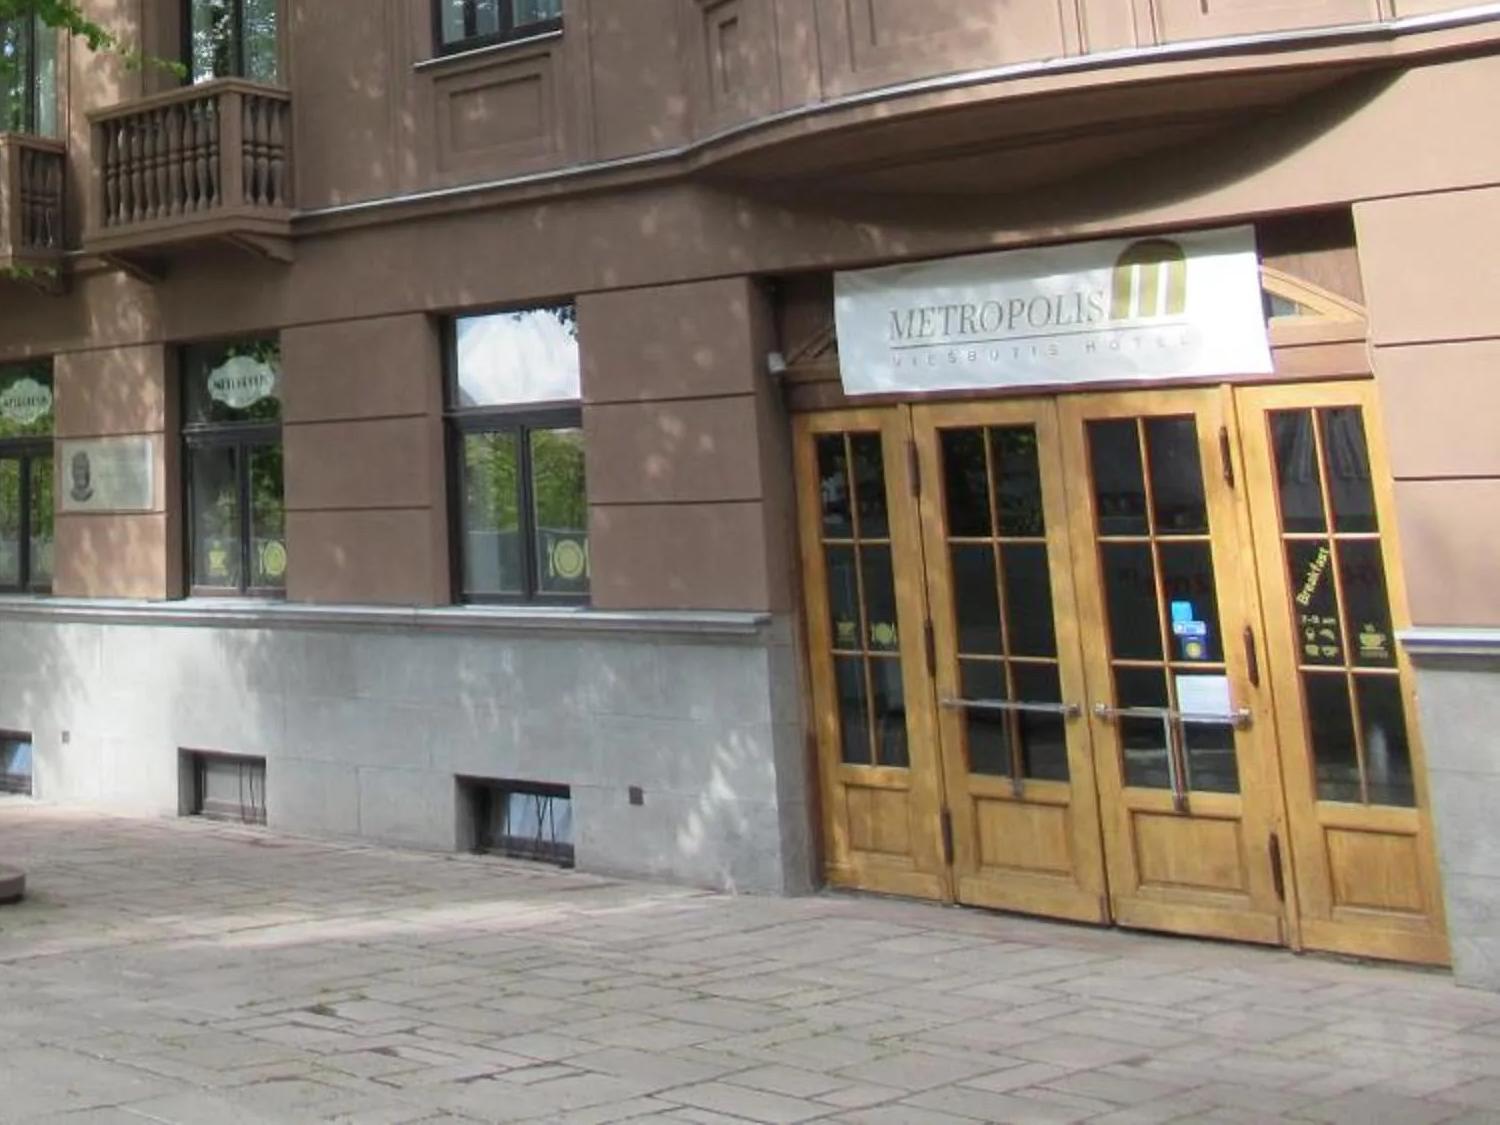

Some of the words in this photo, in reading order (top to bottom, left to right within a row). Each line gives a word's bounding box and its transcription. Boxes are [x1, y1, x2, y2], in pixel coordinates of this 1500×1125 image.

[889, 290, 1105, 340] METROPOLIS
[1085, 331, 1191, 355] HOTEL
[1296, 546, 1329, 607] Breakfast
